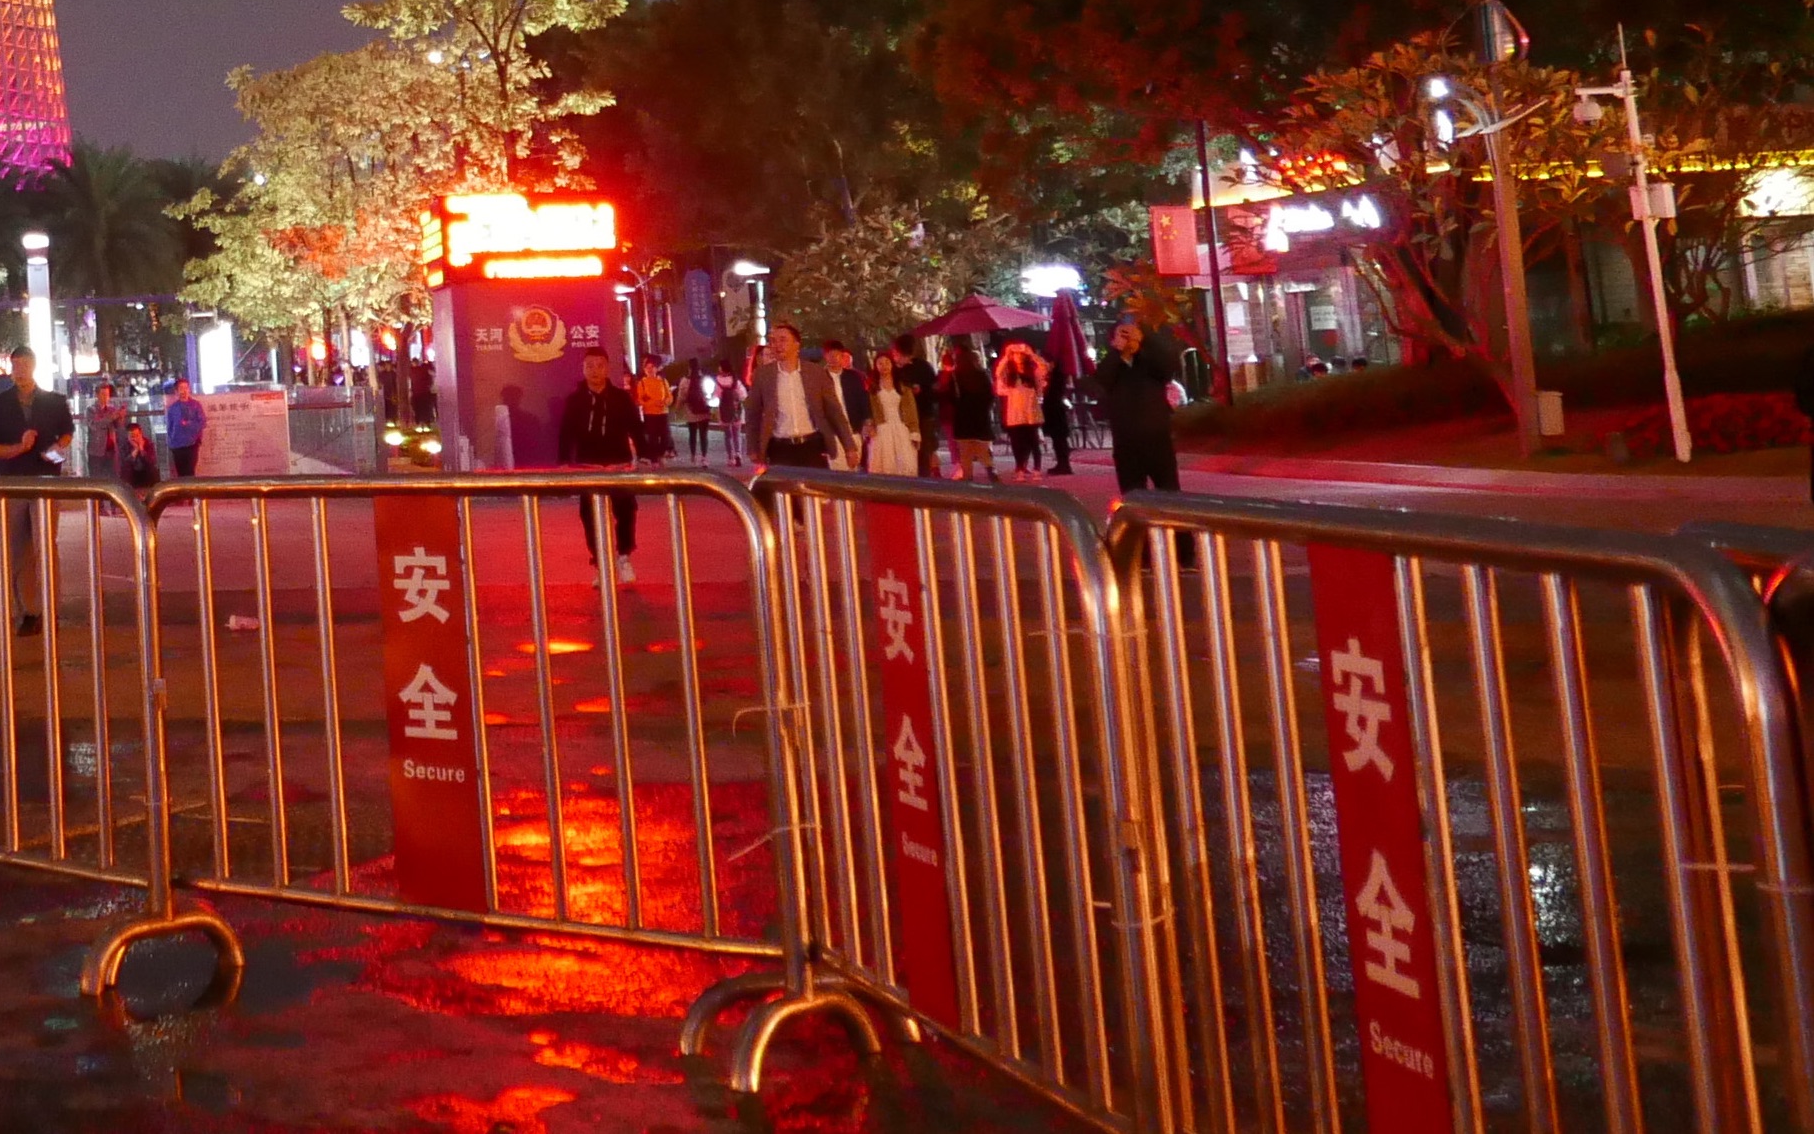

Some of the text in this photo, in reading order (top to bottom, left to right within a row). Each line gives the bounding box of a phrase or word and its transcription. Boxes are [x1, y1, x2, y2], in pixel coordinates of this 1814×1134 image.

[474, 324, 600, 342] 天河 公安
[393, 546, 459, 741] 安全
[878, 568, 929, 812] 安全
[403, 758, 466, 784] Secure
[901, 830, 937, 867] Secure
[1330, 635, 1421, 1000] 安全
[1368, 1018, 1435, 1080] Secure
